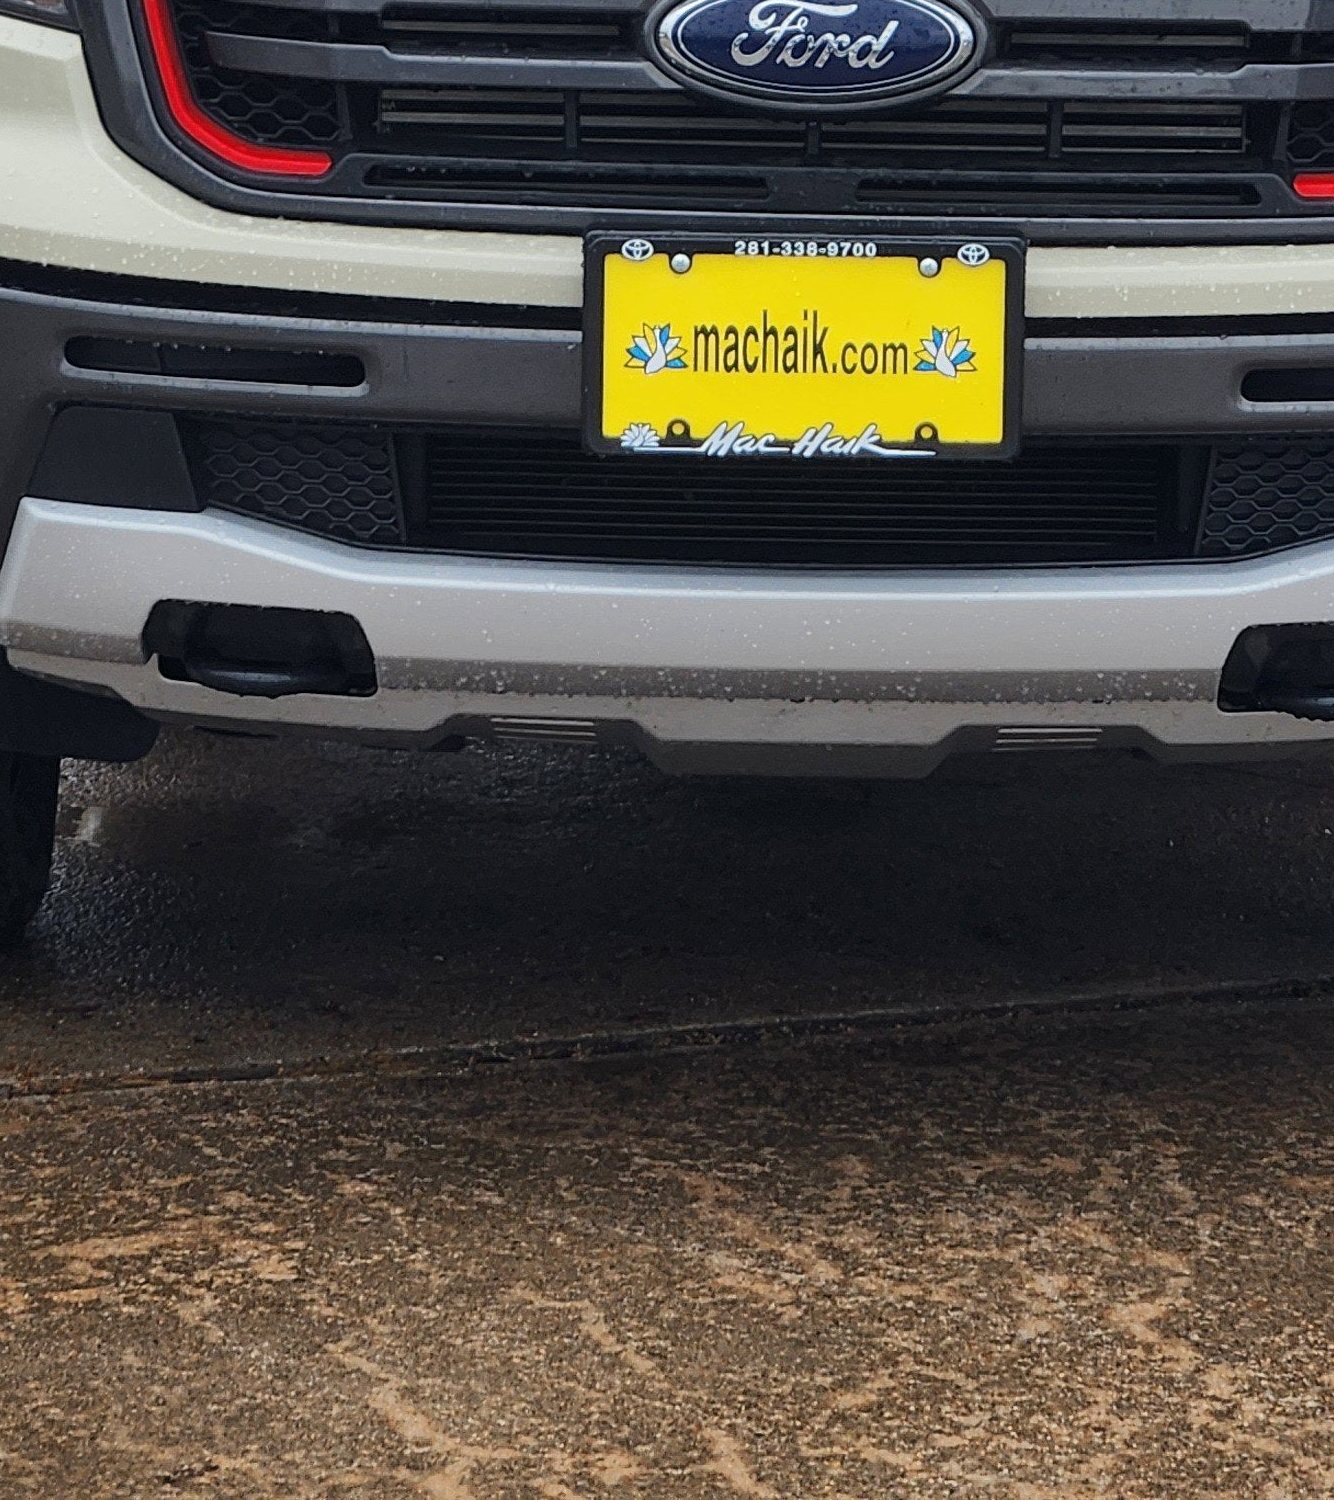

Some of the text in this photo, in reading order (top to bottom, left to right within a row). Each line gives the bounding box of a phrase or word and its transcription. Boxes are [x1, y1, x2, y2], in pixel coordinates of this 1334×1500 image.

[733, 240, 878, 258] 281-338-9700
[692, 309, 909, 375] machaik.com
[701, 420, 884, 457] Mac Haik
